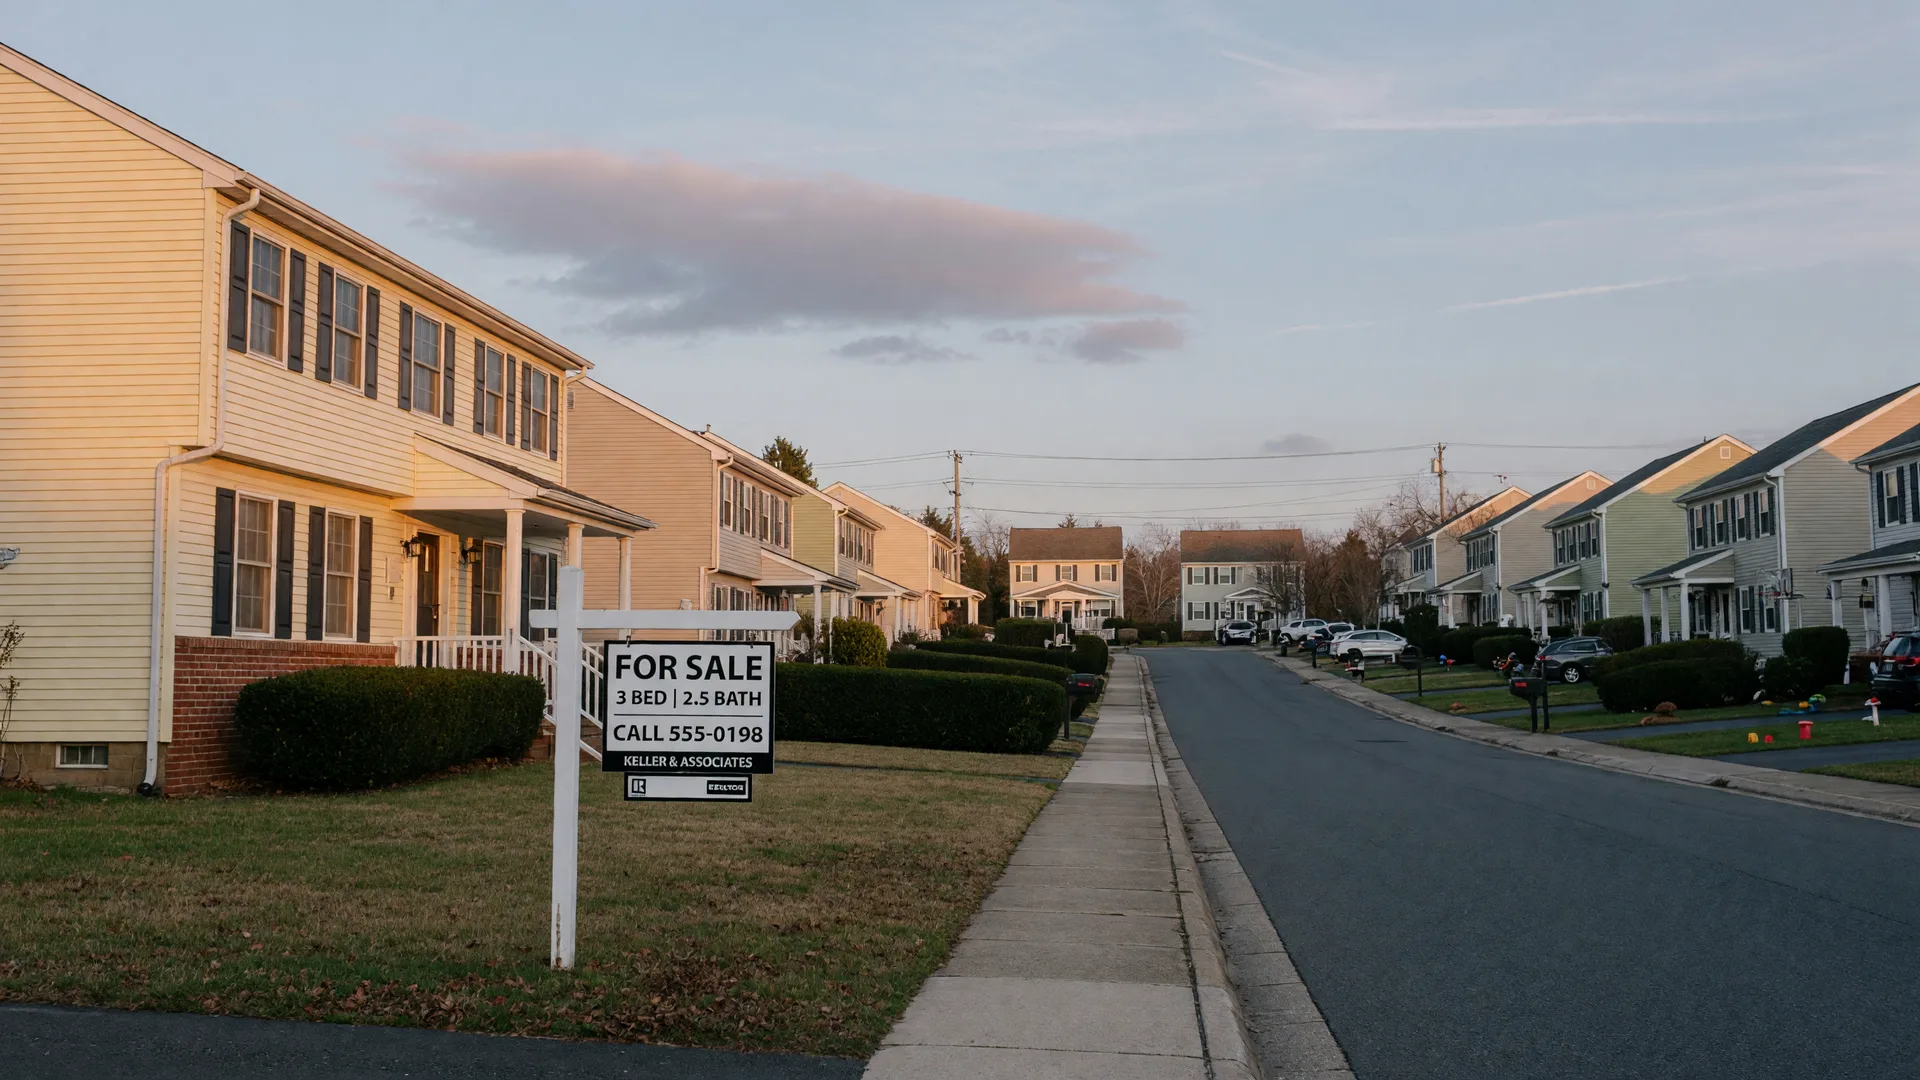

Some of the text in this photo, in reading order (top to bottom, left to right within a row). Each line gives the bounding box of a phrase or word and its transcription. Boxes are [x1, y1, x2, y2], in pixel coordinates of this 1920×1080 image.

[615, 654, 763, 681] FOR SALE
[615, 690, 627, 705] 3
[631, 690, 668, 706] BED
[682, 690, 710, 706] 2.5
[714, 691, 762, 706] BATH
[613, 724, 764, 743] CALL 555-0198
[623, 755, 753, 769] KELLER & ASSOCIATES
